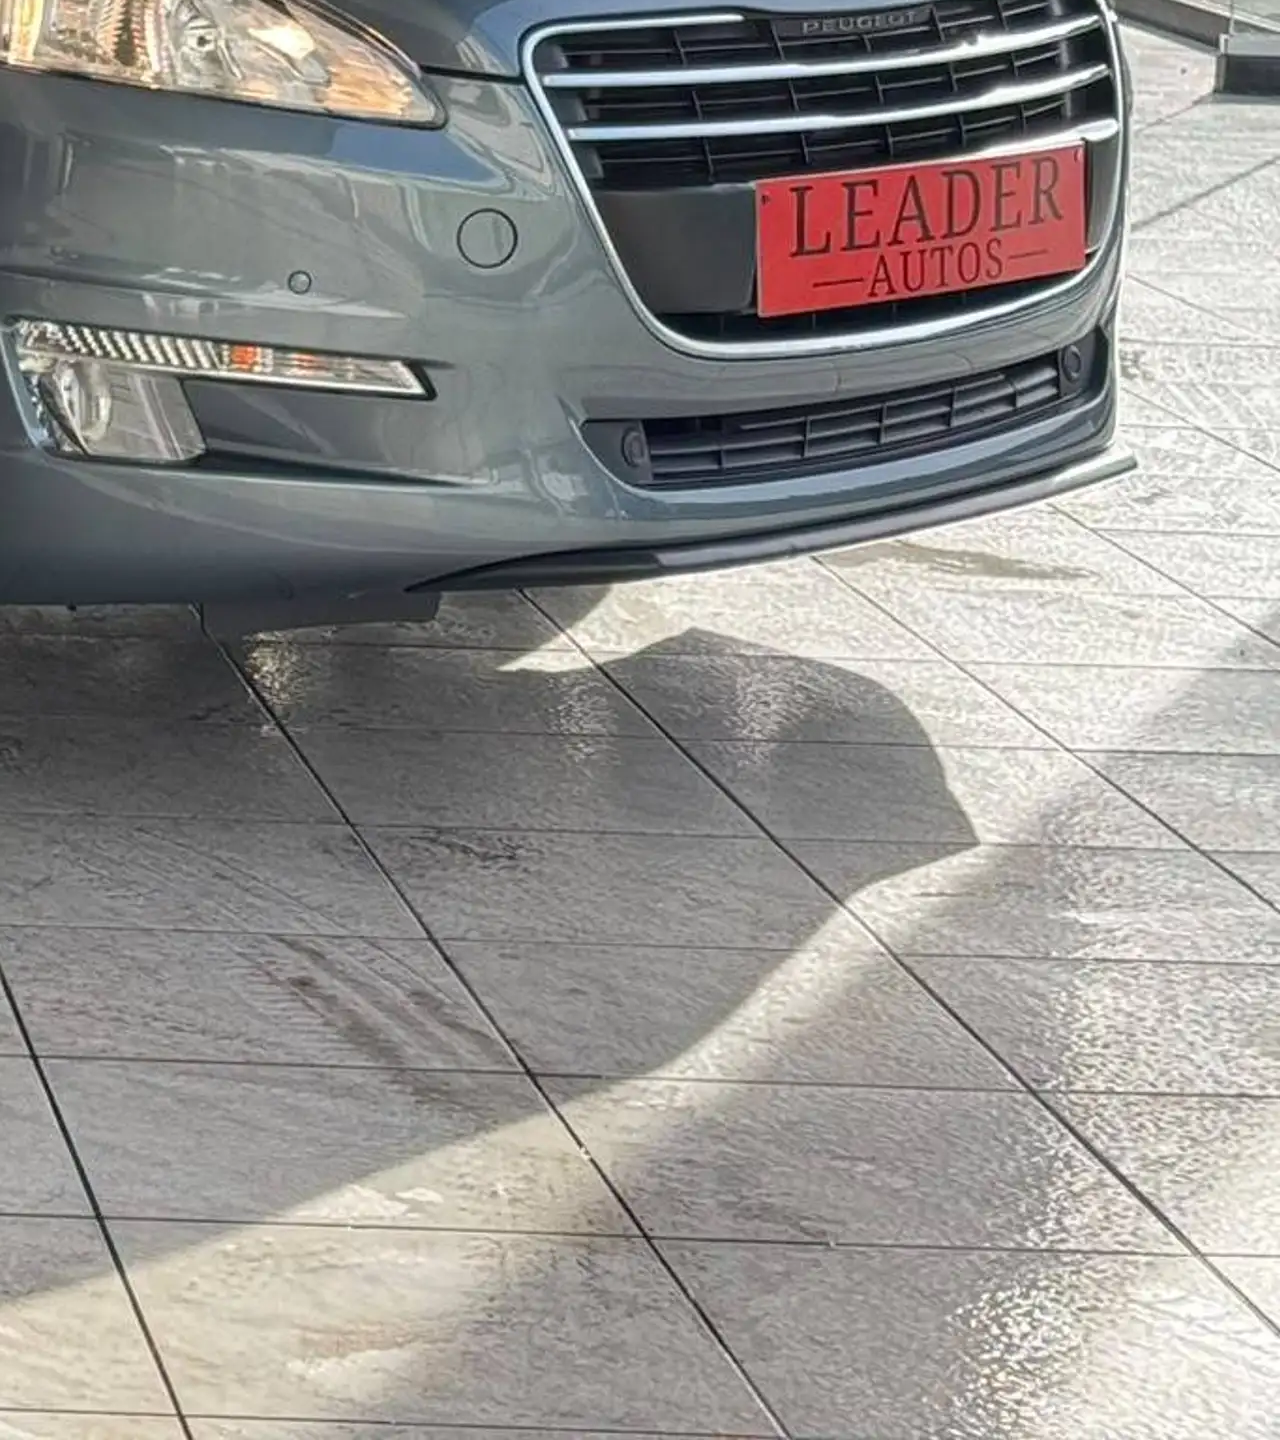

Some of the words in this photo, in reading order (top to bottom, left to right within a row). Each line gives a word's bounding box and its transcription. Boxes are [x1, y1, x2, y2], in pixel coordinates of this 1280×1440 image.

[802, 11, 917, 35] PEUGEOT
[789, 155, 1064, 258] LEADER
[867, 238, 1005, 298] AUTOS
